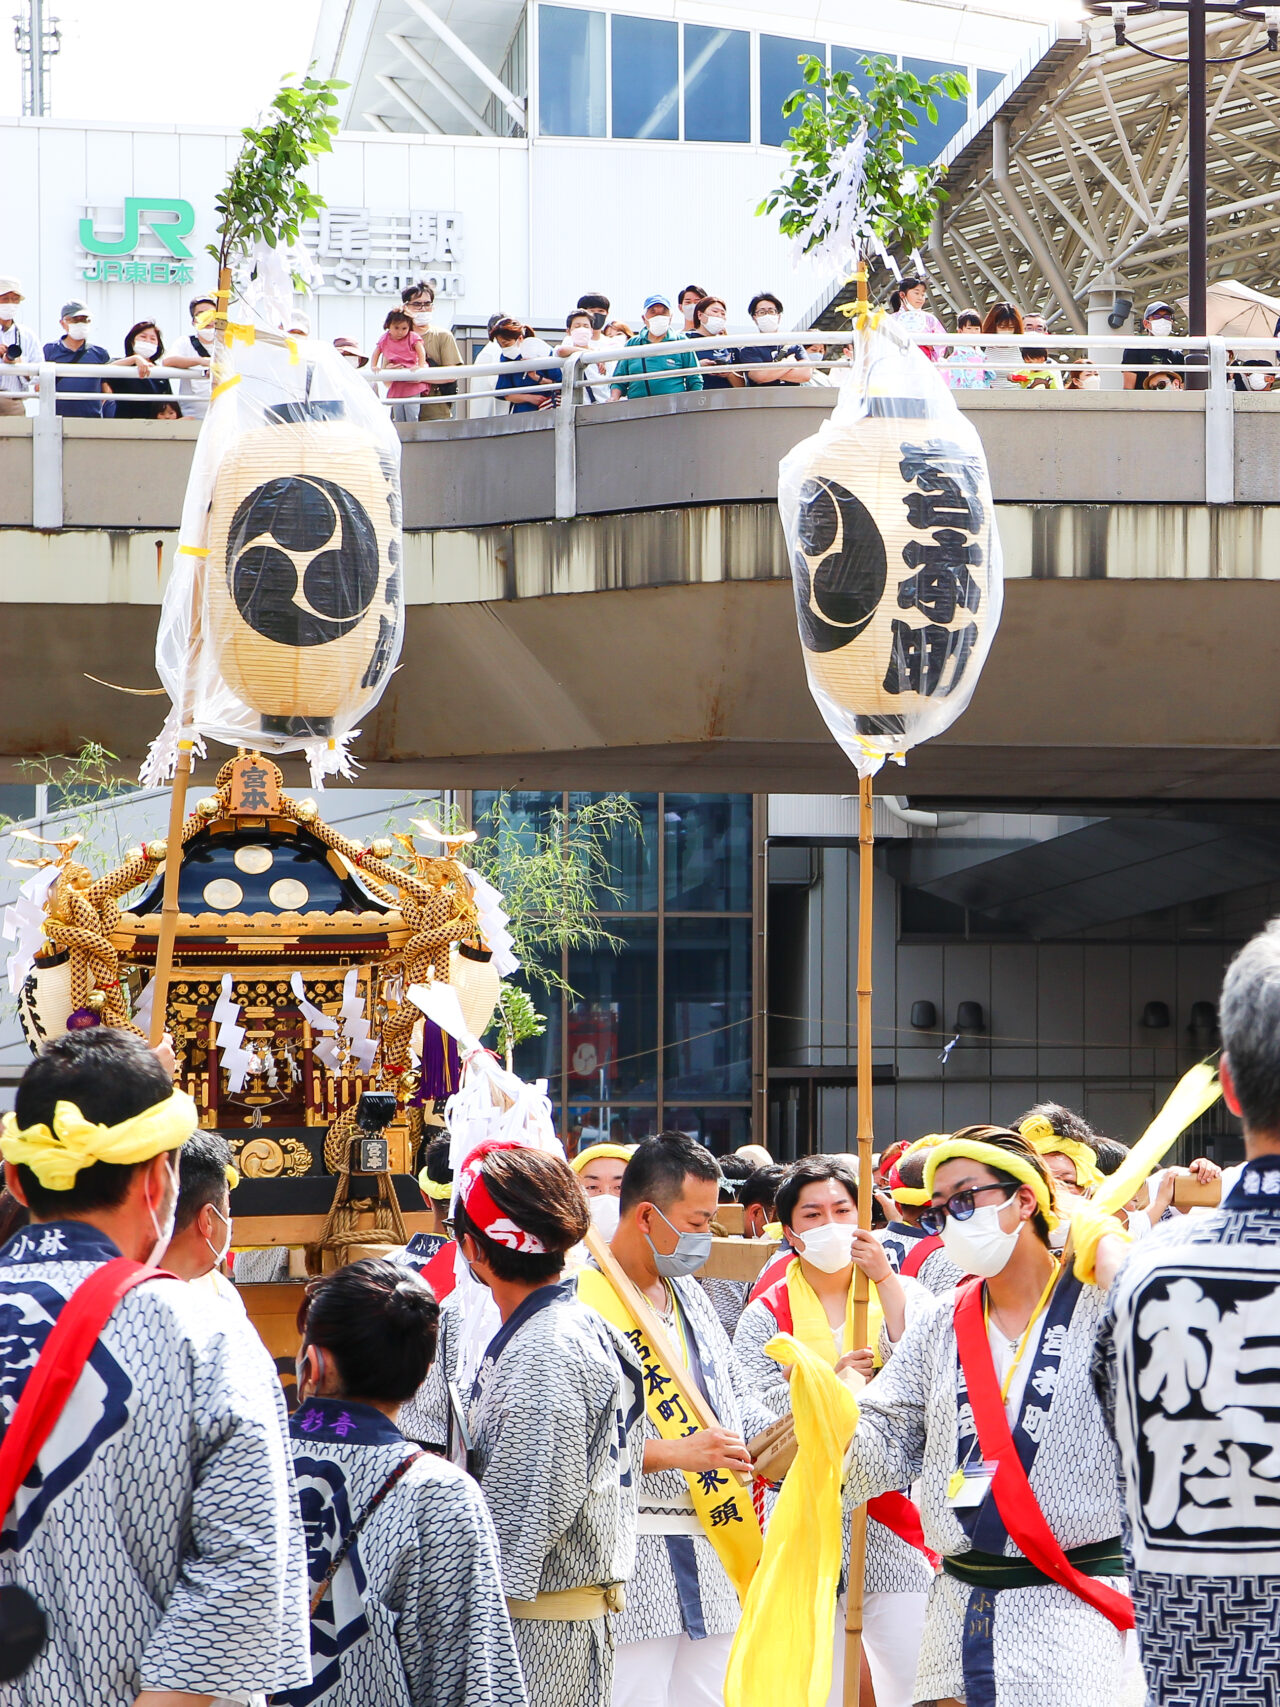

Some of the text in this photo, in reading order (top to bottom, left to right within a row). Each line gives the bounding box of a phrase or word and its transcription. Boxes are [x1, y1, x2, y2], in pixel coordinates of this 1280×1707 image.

[79, 197, 195, 258] JR
[82, 260, 194, 285] JR東日本
[240, 766, 269, 810] 宮本
[366, 1142, 383, 1169] 宮本
[9, 1229, 68, 1261] 小林
[1021, 1324, 1068, 1443] 宮本町
[300, 1408, 357, 1437] 彩音
[624, 1328, 744, 1527] 宮本町衆頭
